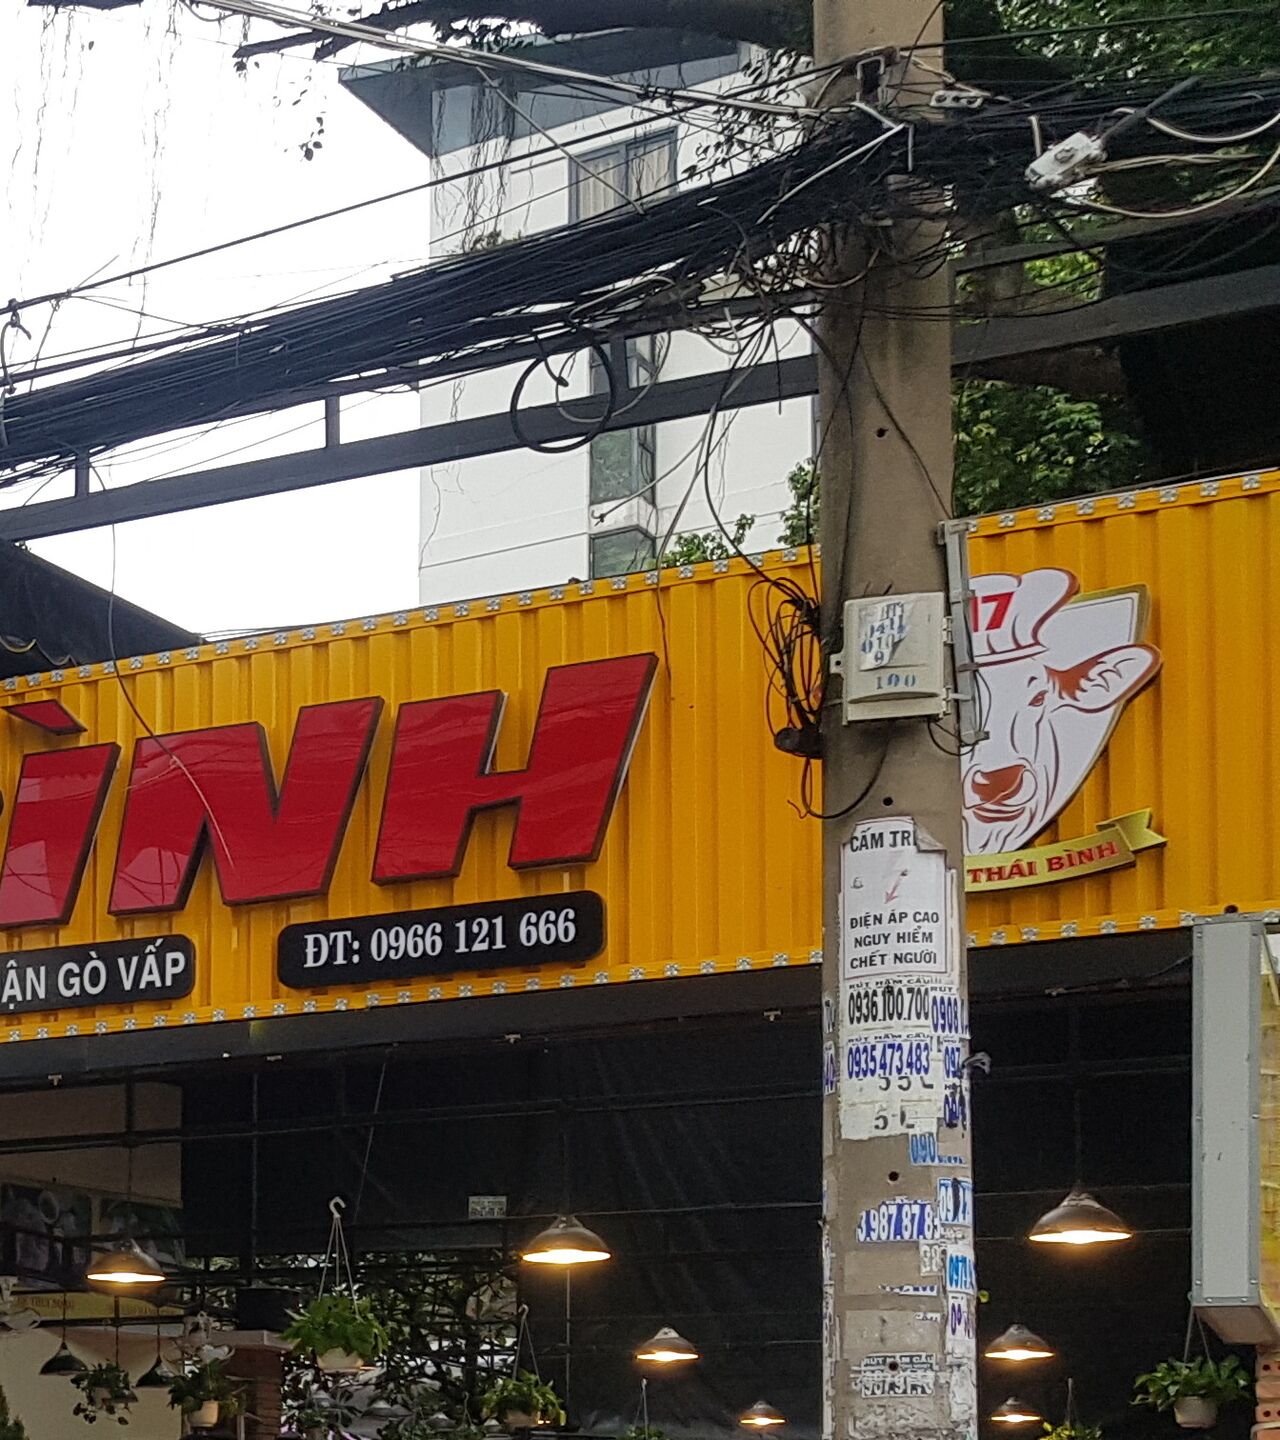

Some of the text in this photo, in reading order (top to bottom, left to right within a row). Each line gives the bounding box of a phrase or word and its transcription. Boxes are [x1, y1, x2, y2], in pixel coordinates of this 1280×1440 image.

[850, 826, 885, 853] CẤM
[966, 840, 1120, 884] THÁI BÌNH
[850, 909, 940, 930] ĐIỆN ÁP CAO
[304, 908, 577, 969] ĐT: 0966 121 666
[854, 926, 934, 949] NGUY HIỂM
[58, 950, 108, 997] GÒ
[116, 937, 187, 991] VẤP
[850, 949, 937, 970] CHẾT NGƯỜI
